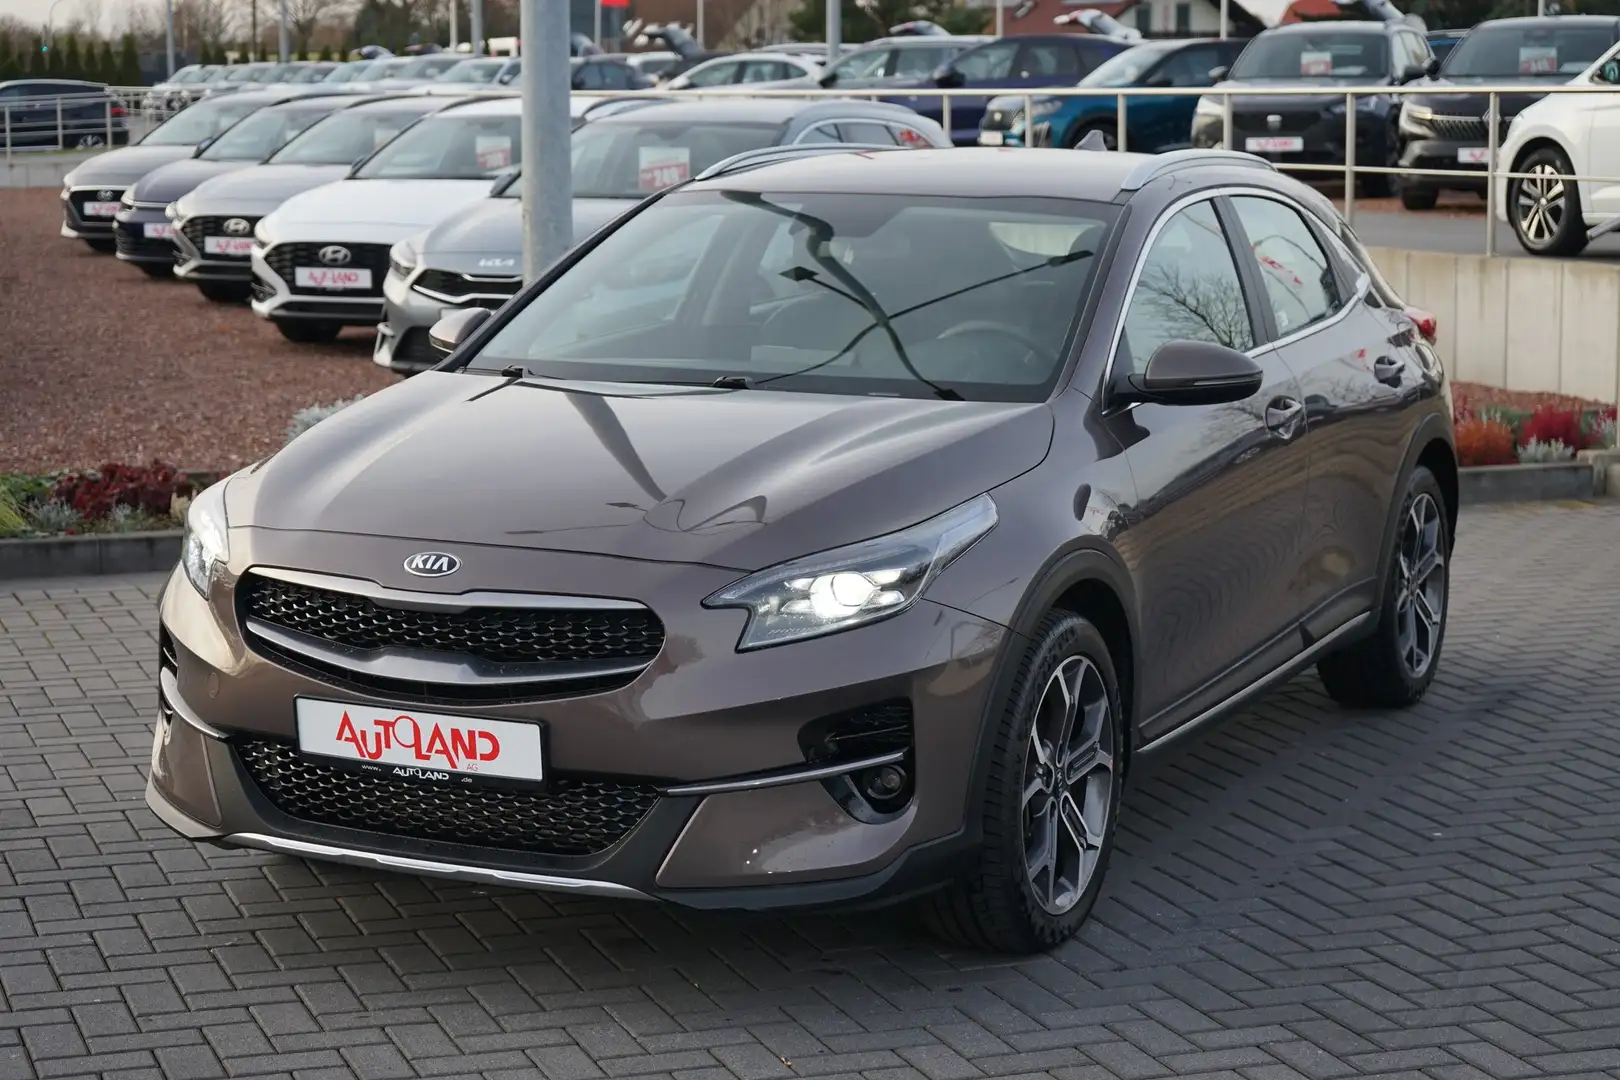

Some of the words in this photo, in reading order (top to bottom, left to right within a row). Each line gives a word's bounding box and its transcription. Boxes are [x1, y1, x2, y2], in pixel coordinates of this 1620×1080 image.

[411, 555, 449, 571] KIA
[336, 710, 500, 769] AUTOLAND
[392, 767, 449, 780] AUTOLAND
[466, 763, 479, 772] AG
